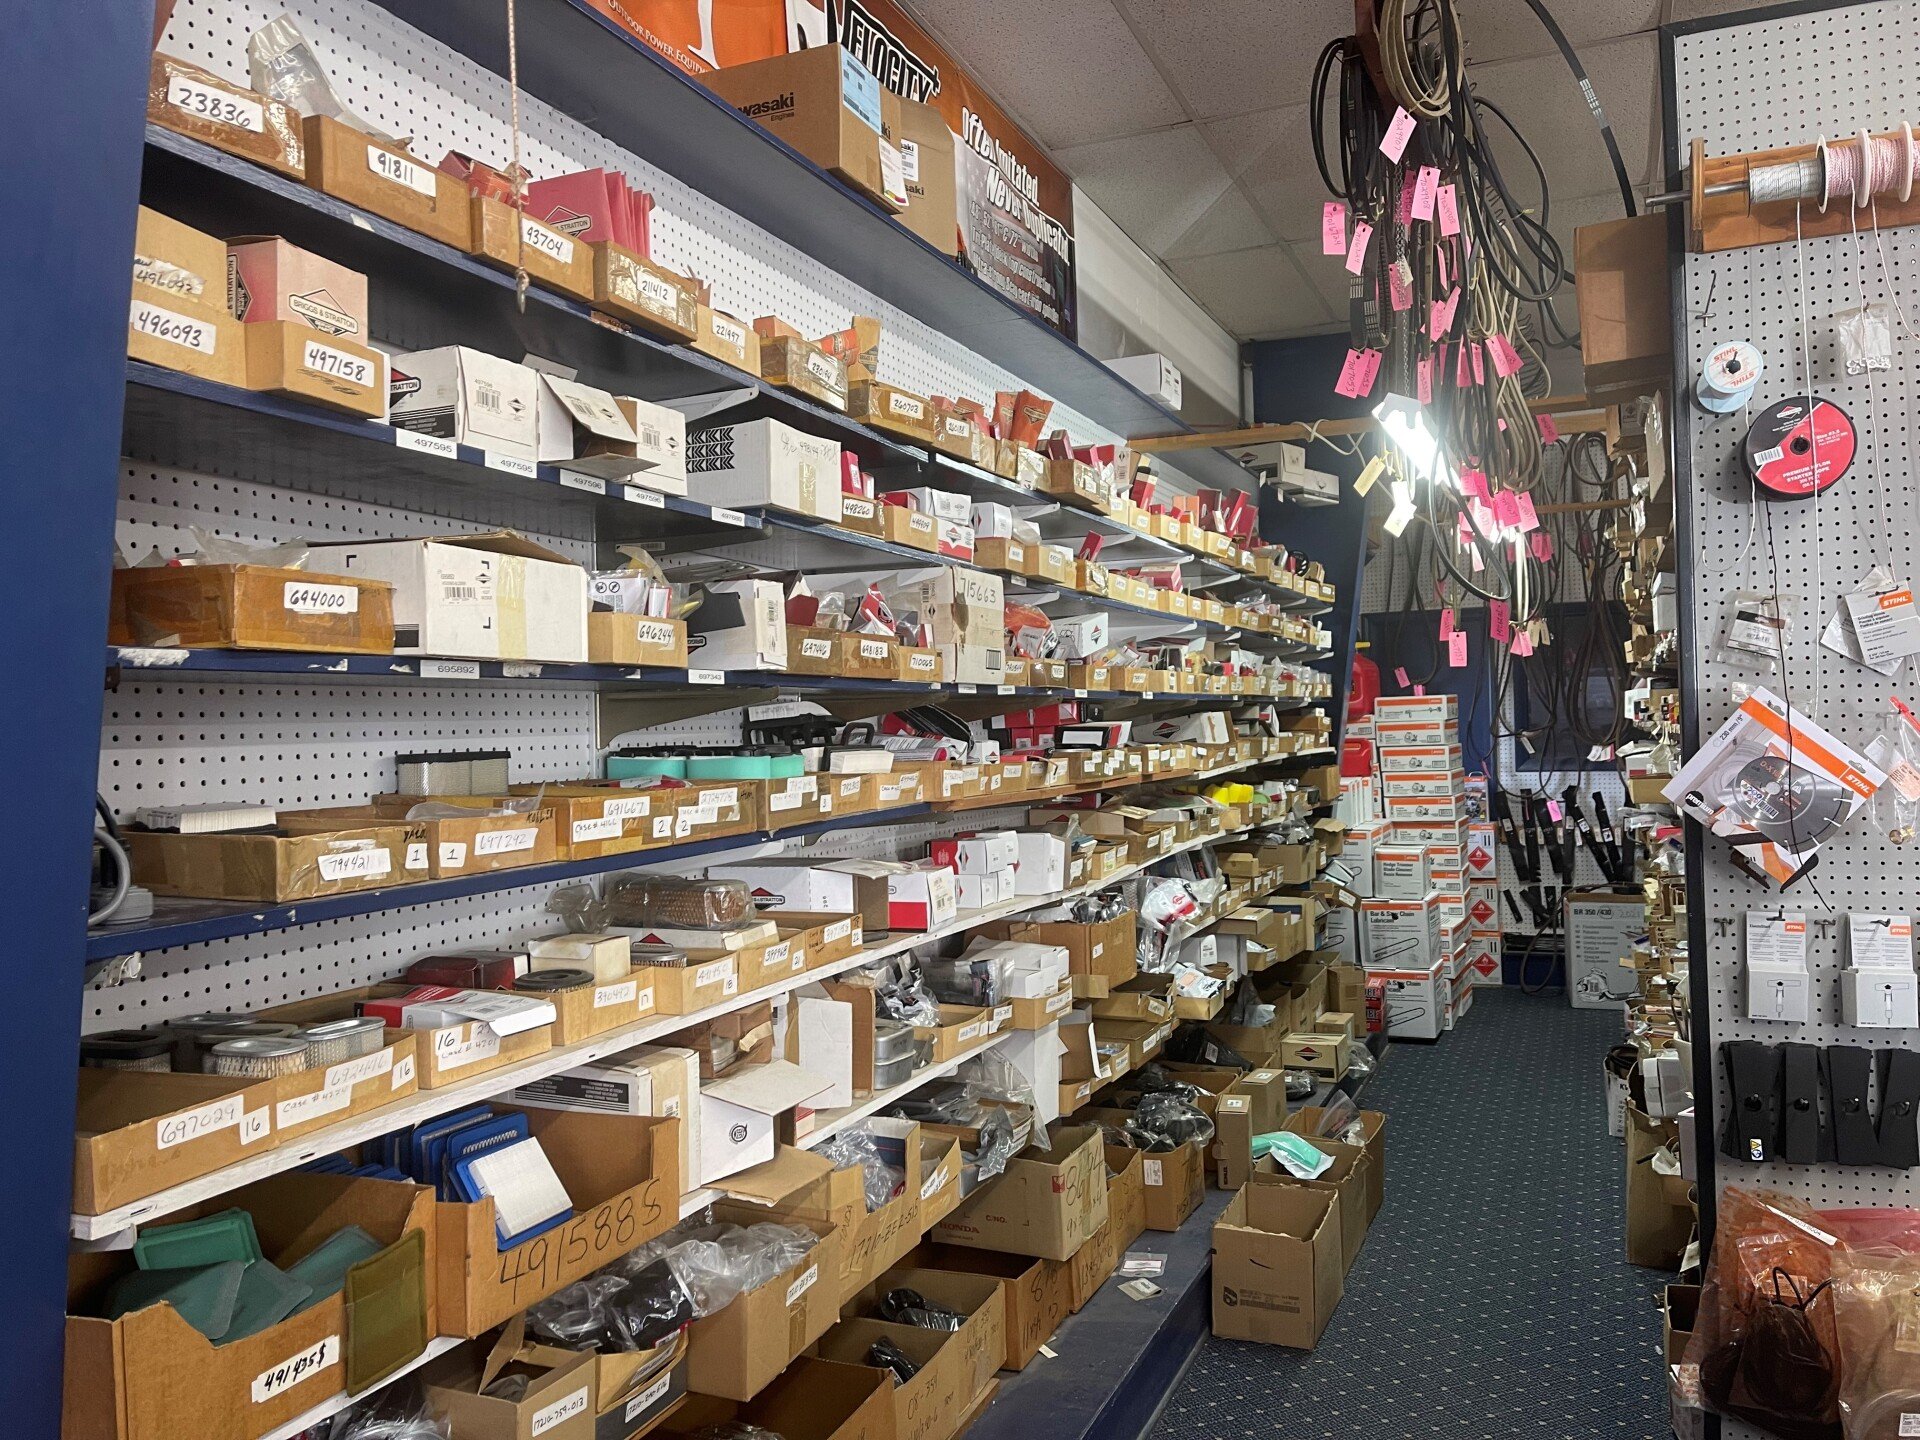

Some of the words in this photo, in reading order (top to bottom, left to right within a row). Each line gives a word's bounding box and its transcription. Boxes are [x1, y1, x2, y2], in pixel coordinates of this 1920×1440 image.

[607, 0, 644, 36] OUTDOOR
[645, 29, 674, 56] POWER
[178, 88, 251, 127] 23836
[738, 92, 795, 118] wasaki
[770, 112, 795, 122] Engines
[962, 105, 998, 164] Often
[377, 152, 414, 185] 91811
[986, 165, 1022, 222] Never
[560, 219, 589, 232] STRATTON
[526, 226, 564, 256] 93704
[641, 280, 669, 301] 211412
[293, 298, 319, 315] BRIGGS
[324, 311, 356, 329] STRATTON
[138, 311, 203, 348] 496093
[1713, 347, 1737, 363] STIHL
[309, 348, 366, 382] 497158
[390, 380, 418, 392] TRATTON
[1730, 371, 1755, 388] STIHL
[414, 438, 453, 454] 497595
[500, 458, 534, 474] 497595
[844, 501, 871, 516] 498260
[289, 588, 346, 608] 694000
[959, 577, 997, 603] 715663
[1883, 595, 1909, 607] STIHL
[437, 664, 475, 675] 695892
[1719, 730, 1731, 742] 230
[1728, 722, 1738, 733] mm
[1845, 773, 1872, 795] STIHL
[607, 802, 644, 816] 691667
[575, 822, 593, 834] Case
[658, 820, 666, 833] 2
[681, 820, 689, 832] 2
[479, 833, 528, 850] 697242
[412, 848, 421, 862] 1
[447, 848, 458, 860] 1
[329, 854, 370, 872] 794421
[1573, 908, 1584, 916] BR
[1584, 908, 1596, 916] 350
[1600, 908, 1612, 916] 430
[437, 1031, 455, 1051] 16
[399, 1063, 411, 1080] 16
[282, 1099, 308, 1113] Case
[311, 1092, 320, 1101] #
[160, 1105, 236, 1144] 697029
[244, 1116, 262, 1138] 16
[940, 1221, 980, 1235] HONDA
